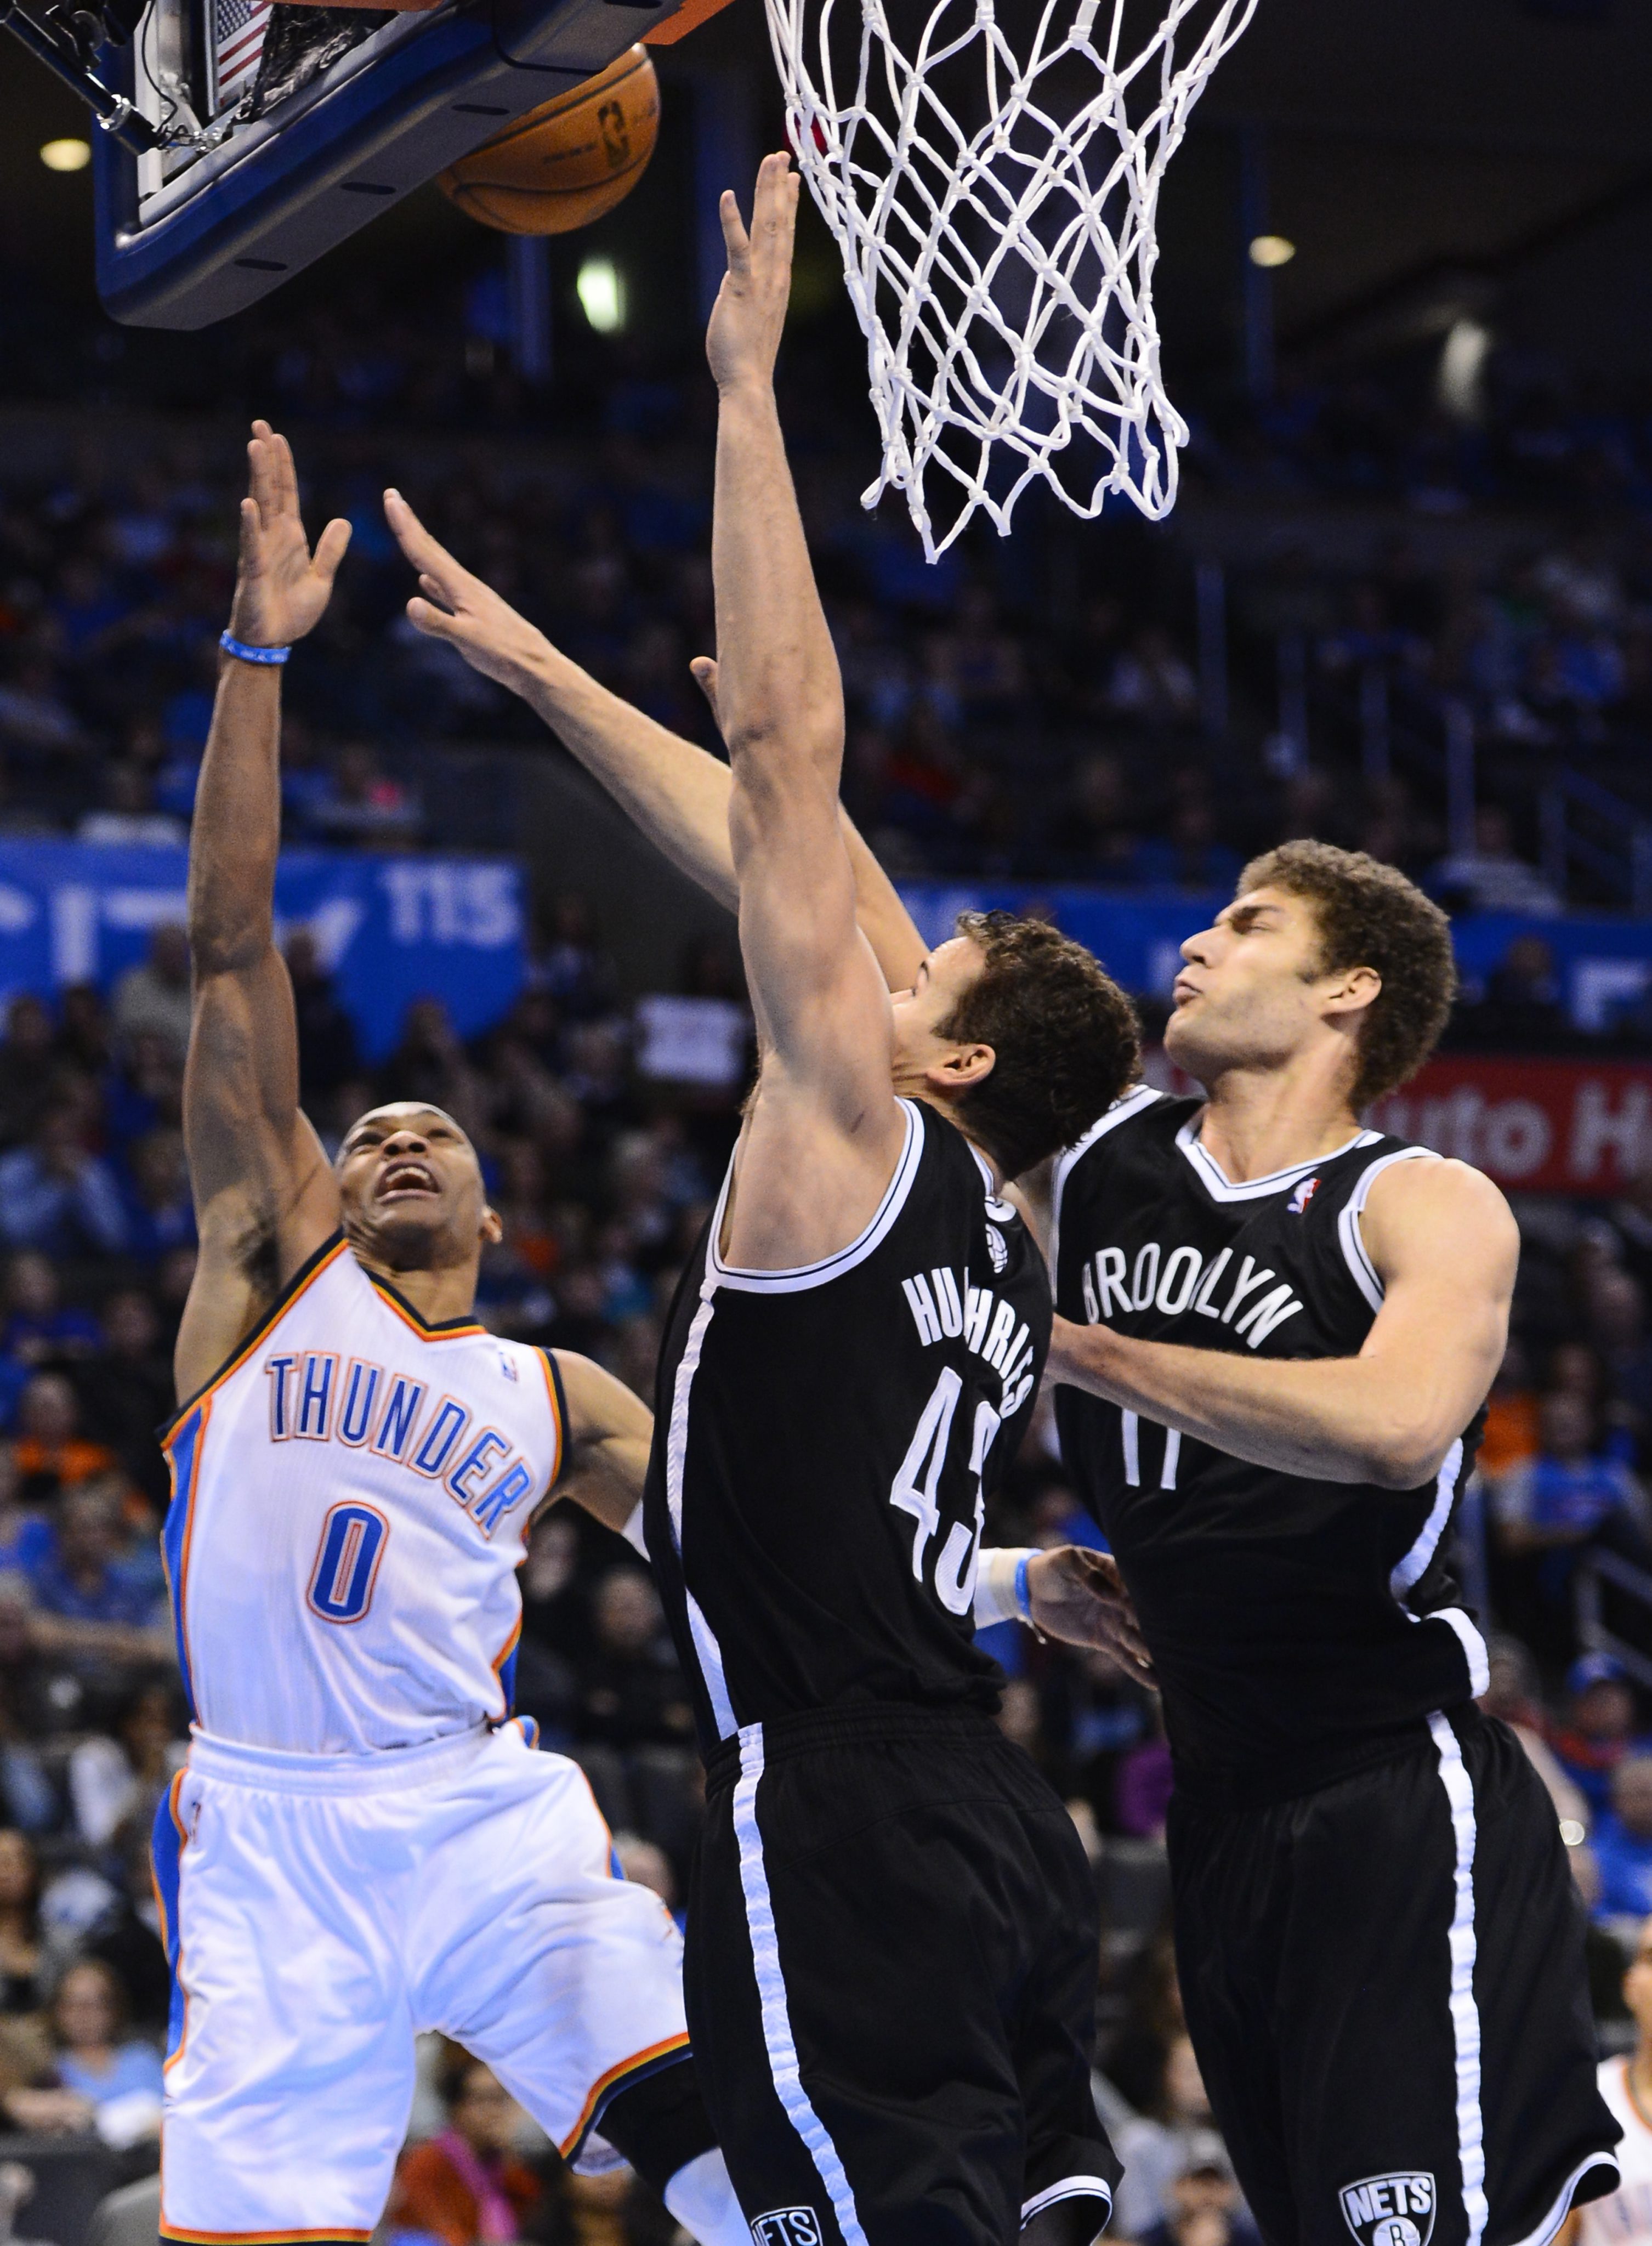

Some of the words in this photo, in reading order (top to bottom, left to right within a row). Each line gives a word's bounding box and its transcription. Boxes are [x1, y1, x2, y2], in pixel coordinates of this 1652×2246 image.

[1361, 1083, 1552, 1178] uto
[265, 1350, 537, 1541] THUNDER
[305, 1500, 390, 1626] 0
[1345, 2176, 1432, 2228] NETS
